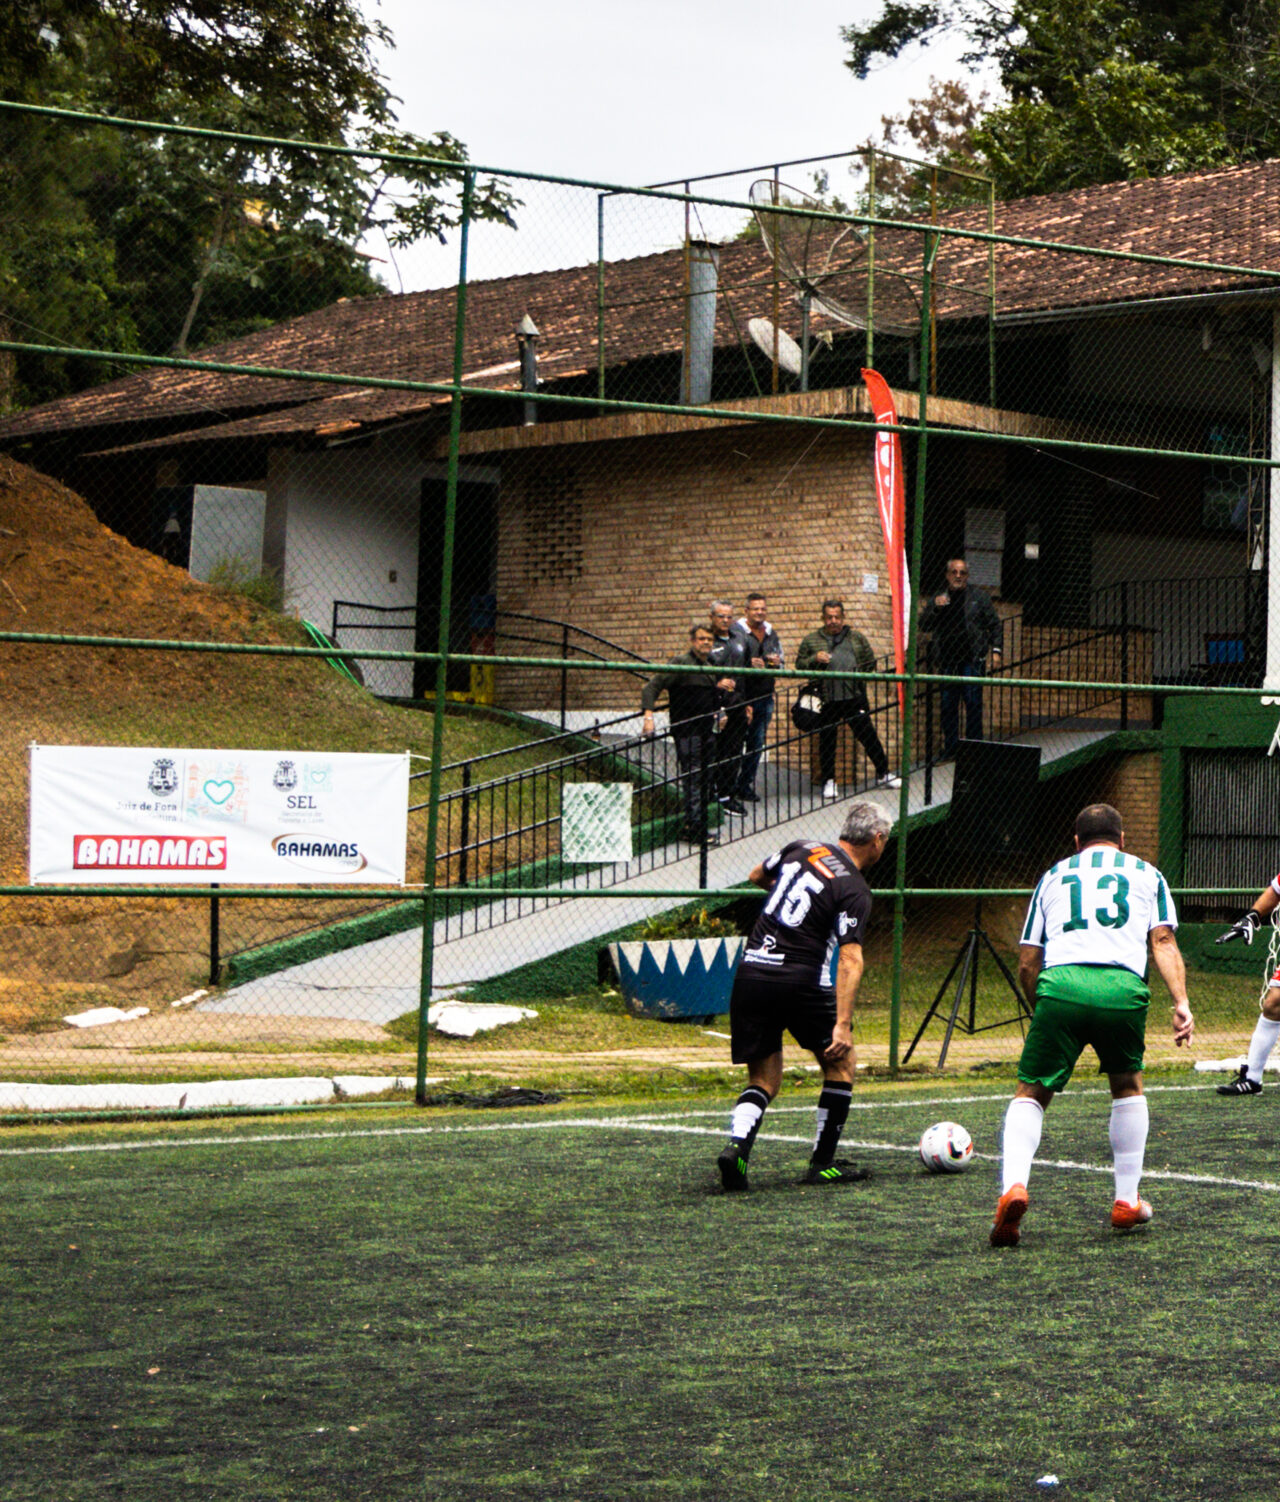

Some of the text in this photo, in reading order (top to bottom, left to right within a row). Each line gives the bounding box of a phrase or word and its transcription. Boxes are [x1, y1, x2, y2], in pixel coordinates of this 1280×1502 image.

[139, 801, 152, 811] de
[154, 801, 177, 811] Fora
[287, 795, 317, 809] SEL
[76, 838, 226, 866] BAHAMAS
[277, 842, 359, 857] BAHAMAS
[764, 860, 825, 928] 15
[1061, 873, 1130, 933] 13
